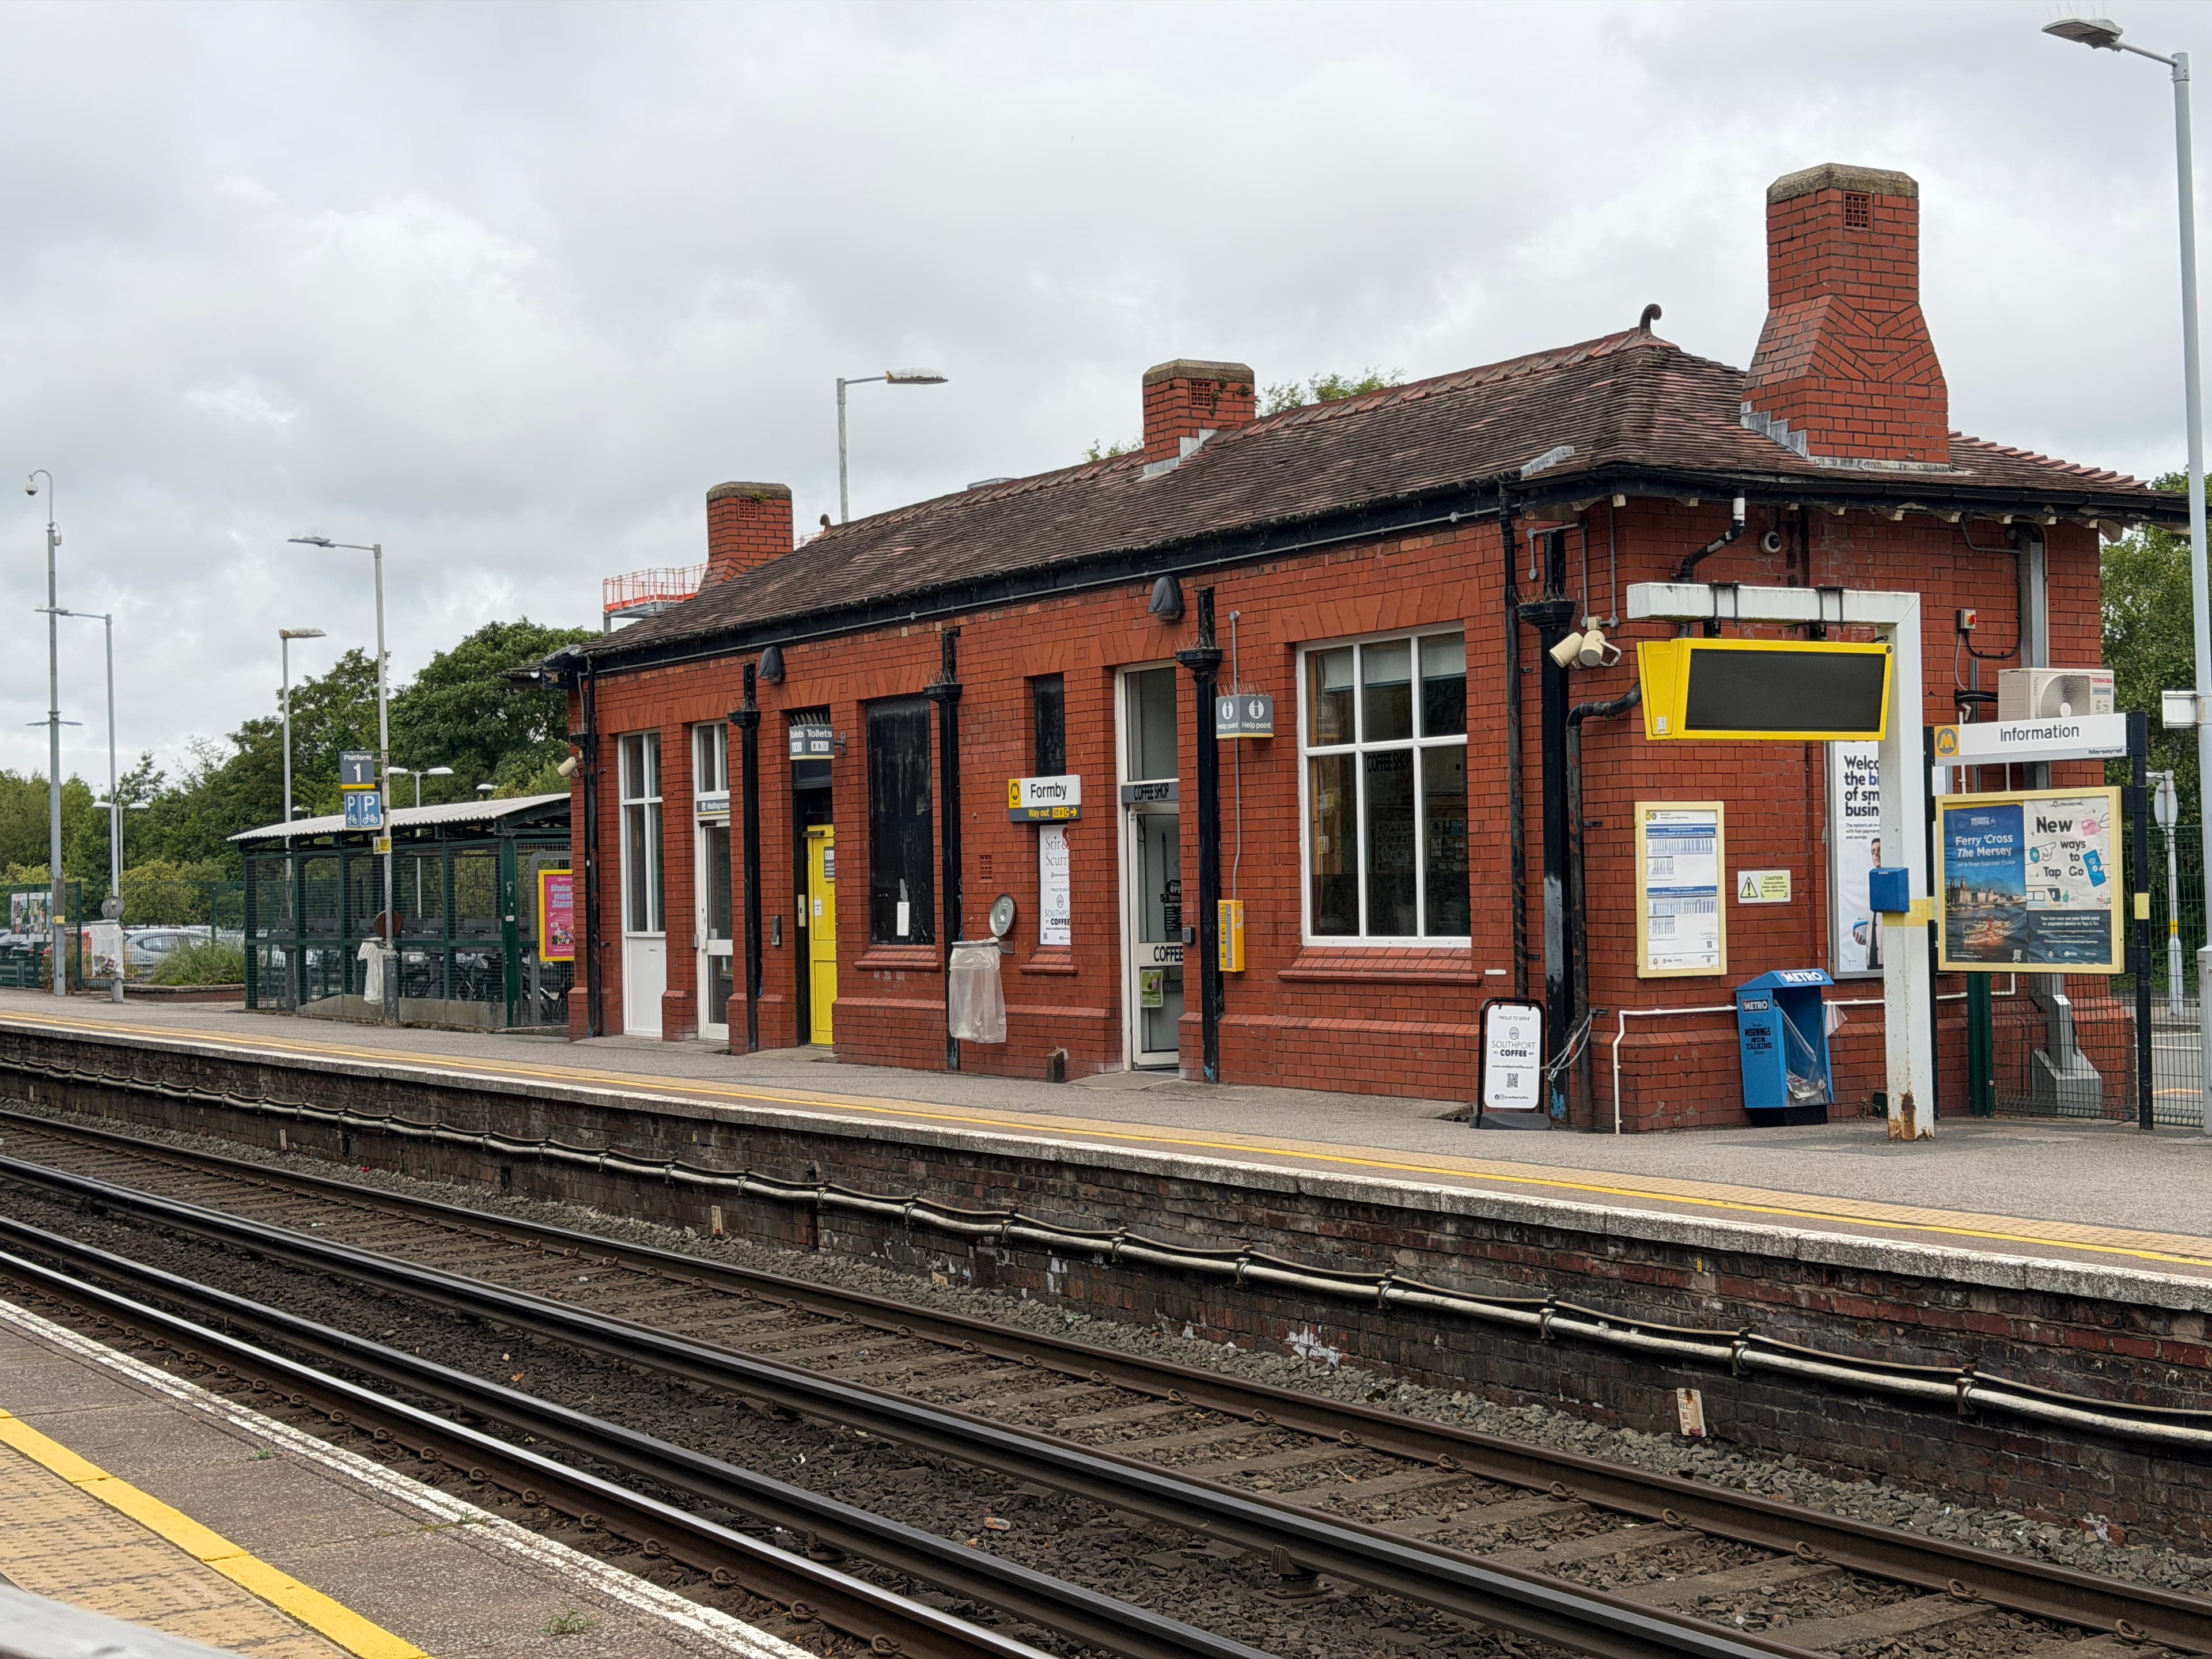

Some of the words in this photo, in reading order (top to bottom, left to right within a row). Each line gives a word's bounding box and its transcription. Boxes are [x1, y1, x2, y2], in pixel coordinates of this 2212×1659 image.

[1228, 721, 1238, 730] point
[1242, 721, 1256, 730] Help
[1256, 721, 1272, 730] point
[790, 729, 804, 738] Toilets
[806, 729, 833, 738] Toilets
[2000, 724, 2080, 742] Information
[2088, 747, 2123, 756] Merseyrail
[1367, 753, 1392, 772] COFFEE
[1392, 751, 1411, 771] SHOP
[353, 763, 361, 782] 1
[1844, 771, 1866, 786] the
[1031, 782, 1067, 801] Formby
[1134, 783, 1154, 801] COFFEE
[1154, 782, 1169, 800] SHOP
[1844, 786, 1859, 801] of
[347, 796, 355, 812] P
[364, 796, 375, 812] P
[1028, 809, 1040, 819] Way
[1040, 808, 1050, 817] out
[2036, 816, 2073, 834] New
[1046, 835, 1060, 851] Stir
[1955, 836, 1982, 846] Ferry
[1983, 834, 2013, 844] 'Cross
[2060, 840, 2086, 851] ways
[1957, 848, 1974, 858] The
[1976, 846, 2012, 857] Mersey
[2069, 852, 2080, 862] to
[2043, 866, 2062, 880] Tap
[2069, 866, 2084, 877] Go
[551, 884, 571, 892] Make
[1051, 918, 1071, 926] COFFEE
[1153, 945, 1184, 963] COFFEE
[1782, 972, 1823, 983] METRO
[1744, 1000, 1768, 1010] METRO
[1744, 1027, 1771, 1037] MORNINGS
[1491, 1040, 1536, 1050] SOUTHPORT
[1745, 1042, 1772, 1050] TALKING
[1500, 1049, 1527, 1057] COFFEE
